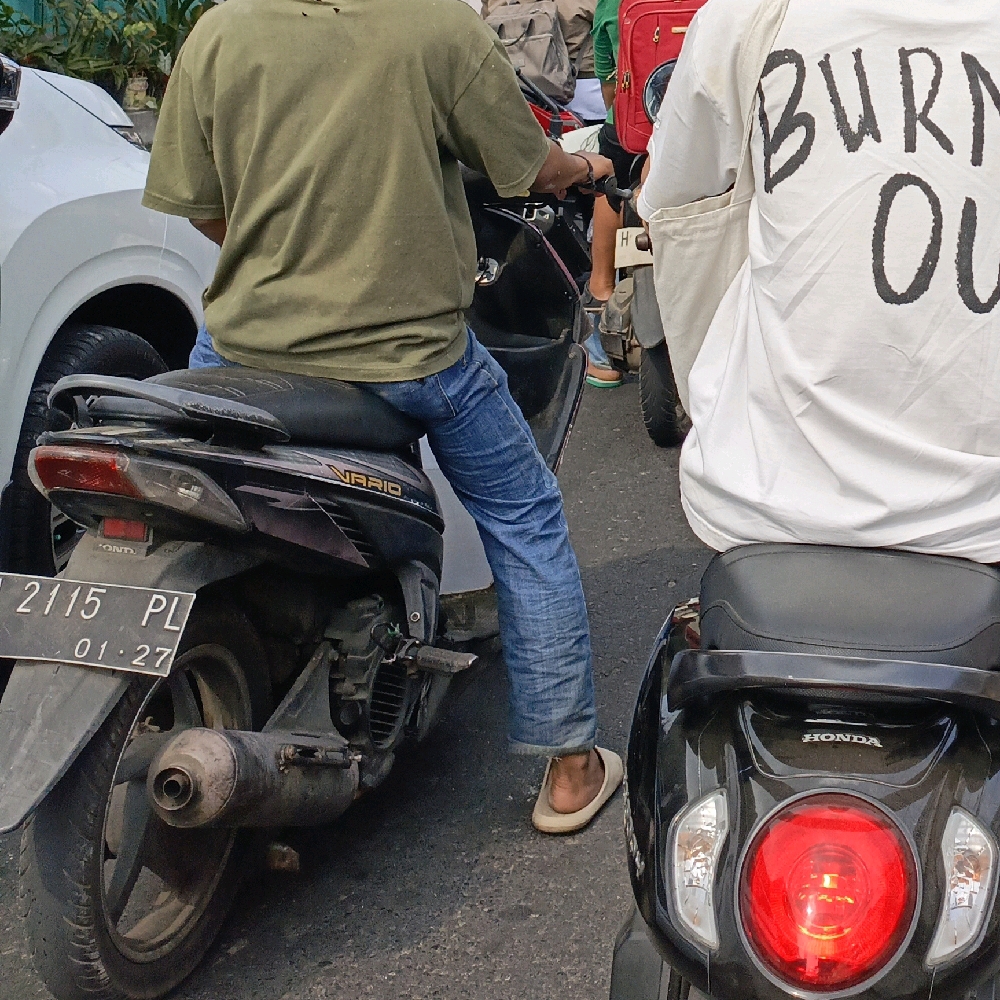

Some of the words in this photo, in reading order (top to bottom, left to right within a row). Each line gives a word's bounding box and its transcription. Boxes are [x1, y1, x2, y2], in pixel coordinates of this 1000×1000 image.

[620, 230, 629, 248] H
[325, 463, 403, 497] VARIO
[16, 581, 107, 621] 2115
[141, 593, 181, 631] PL
[802, 732, 884, 748] HONDA
